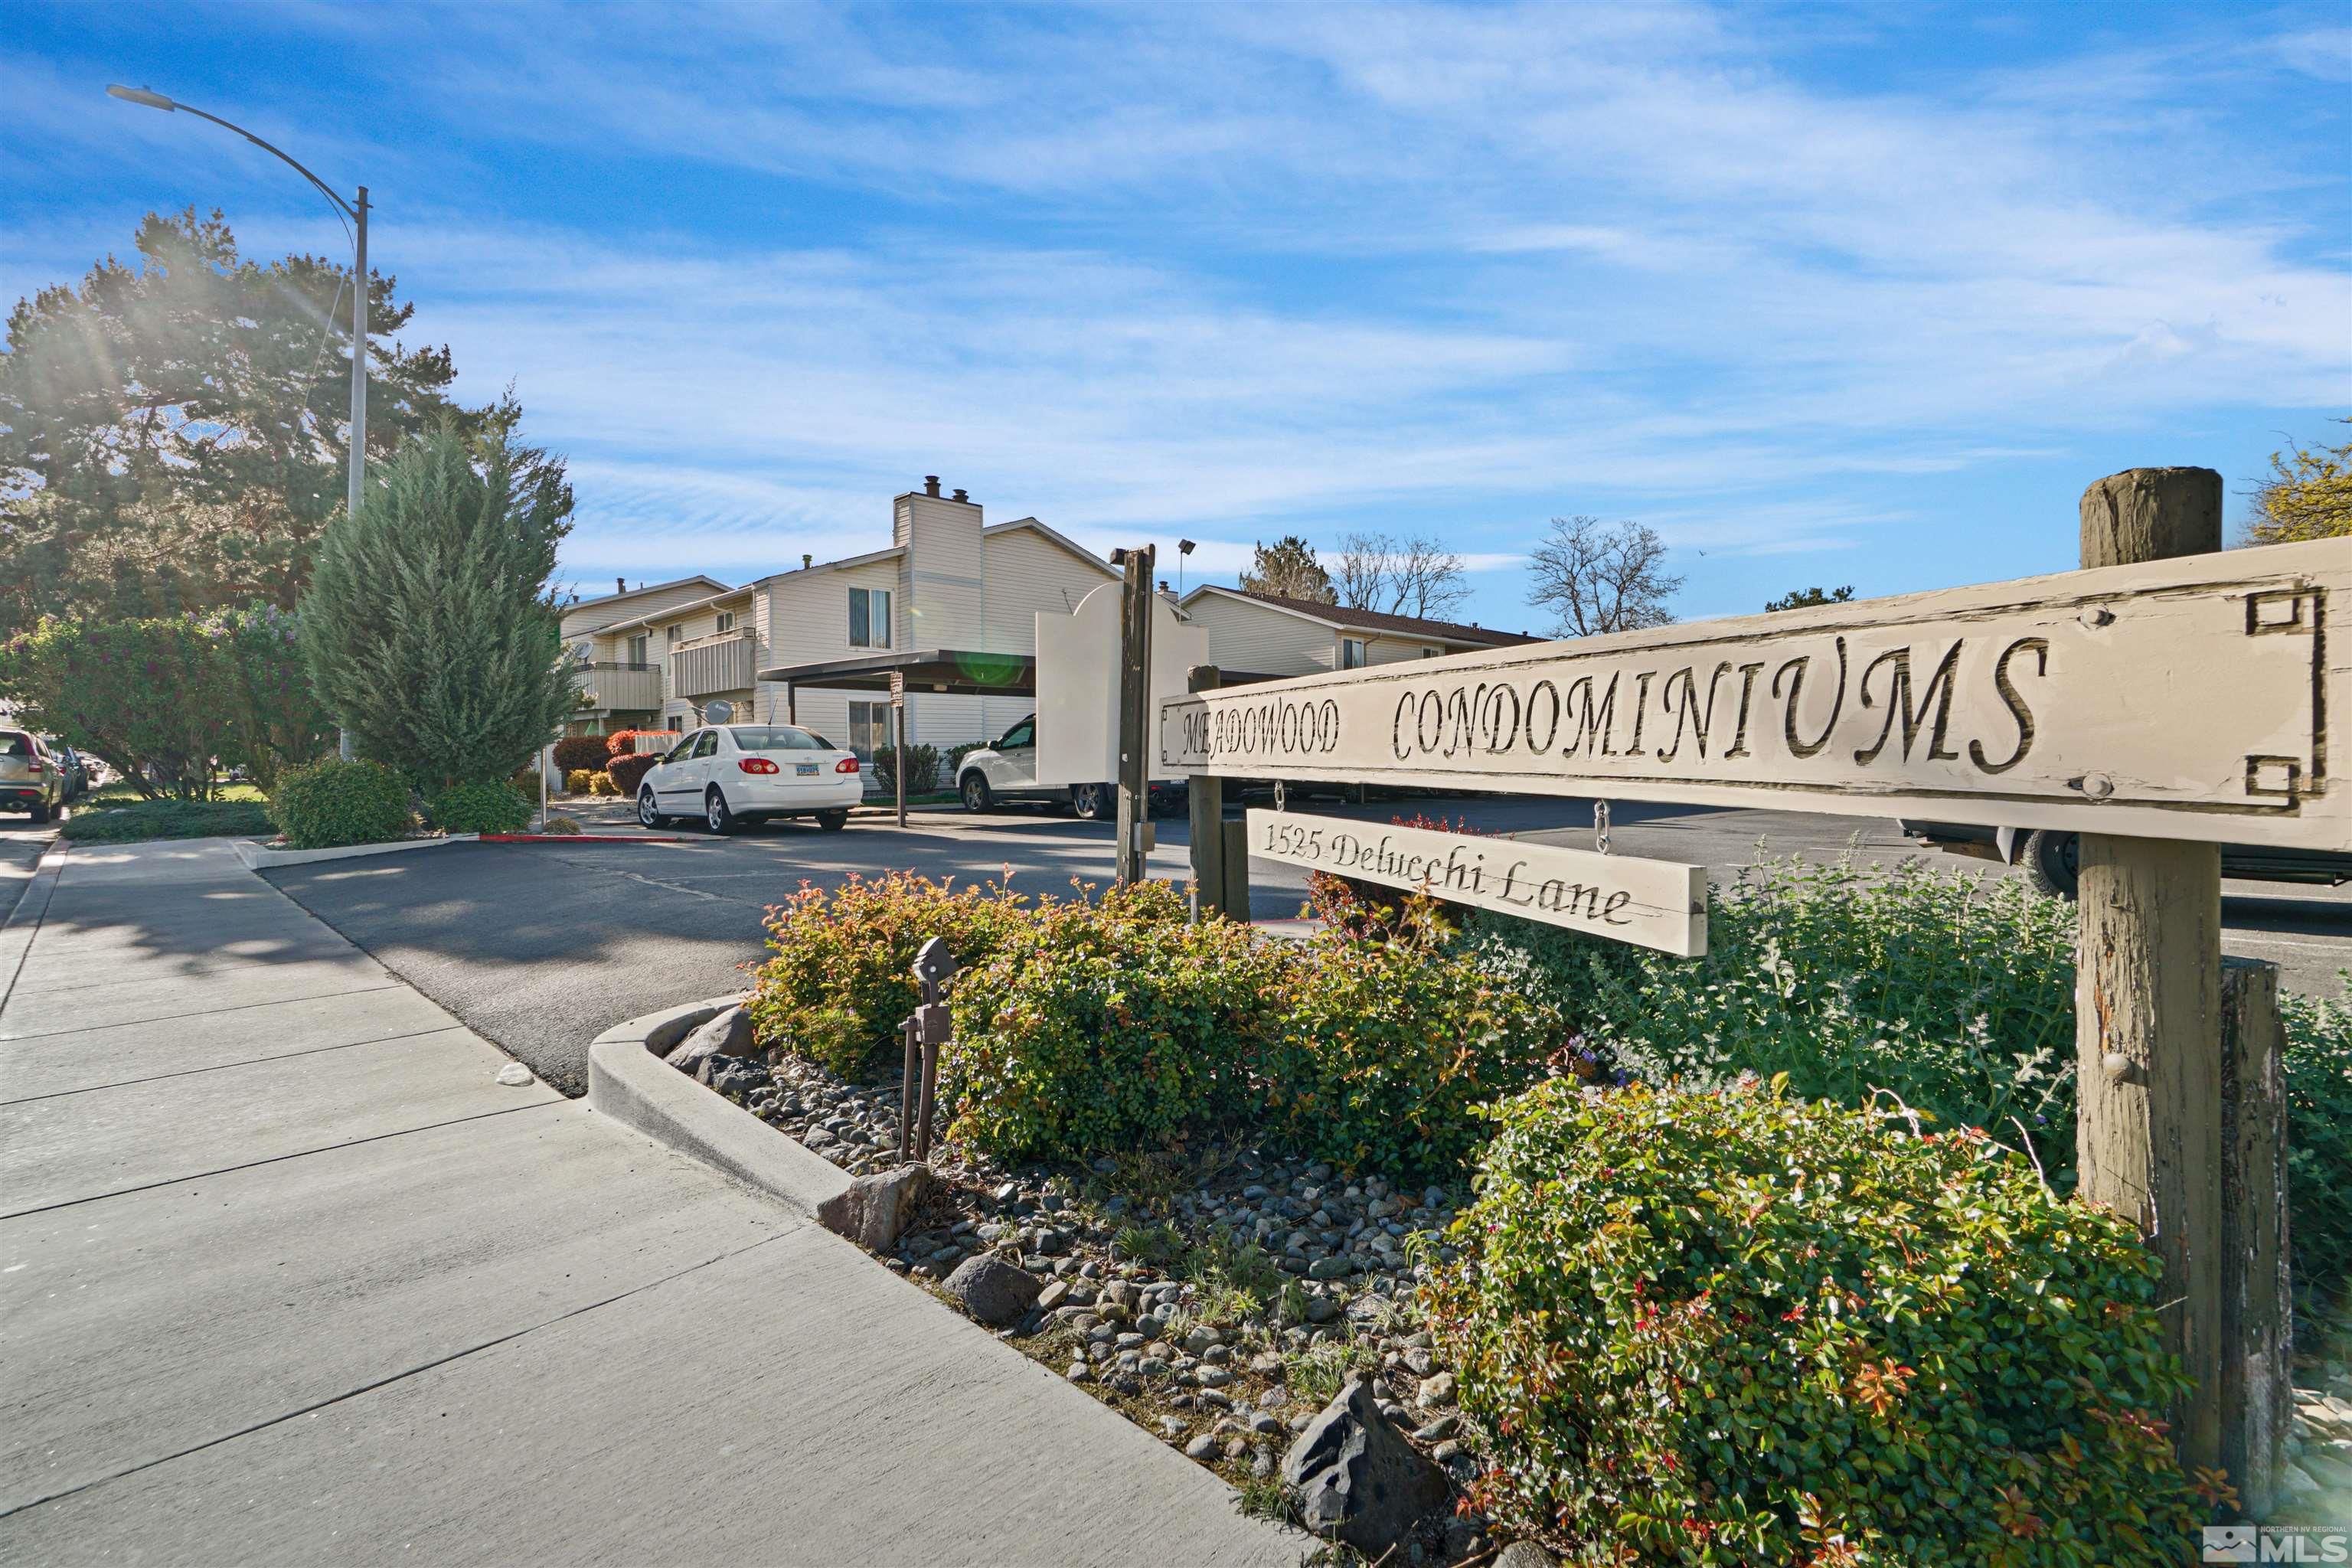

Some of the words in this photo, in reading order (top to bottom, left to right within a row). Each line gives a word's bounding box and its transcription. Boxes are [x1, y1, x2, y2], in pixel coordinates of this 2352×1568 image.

[1183, 697, 1339, 759] MEADOWOOD
[1393, 635, 2050, 774] CONDOMINIUMS
[1264, 823, 1323, 860] 1525
[1331, 834, 1486, 894] Delucchi
[1496, 861, 1633, 925] Lane
